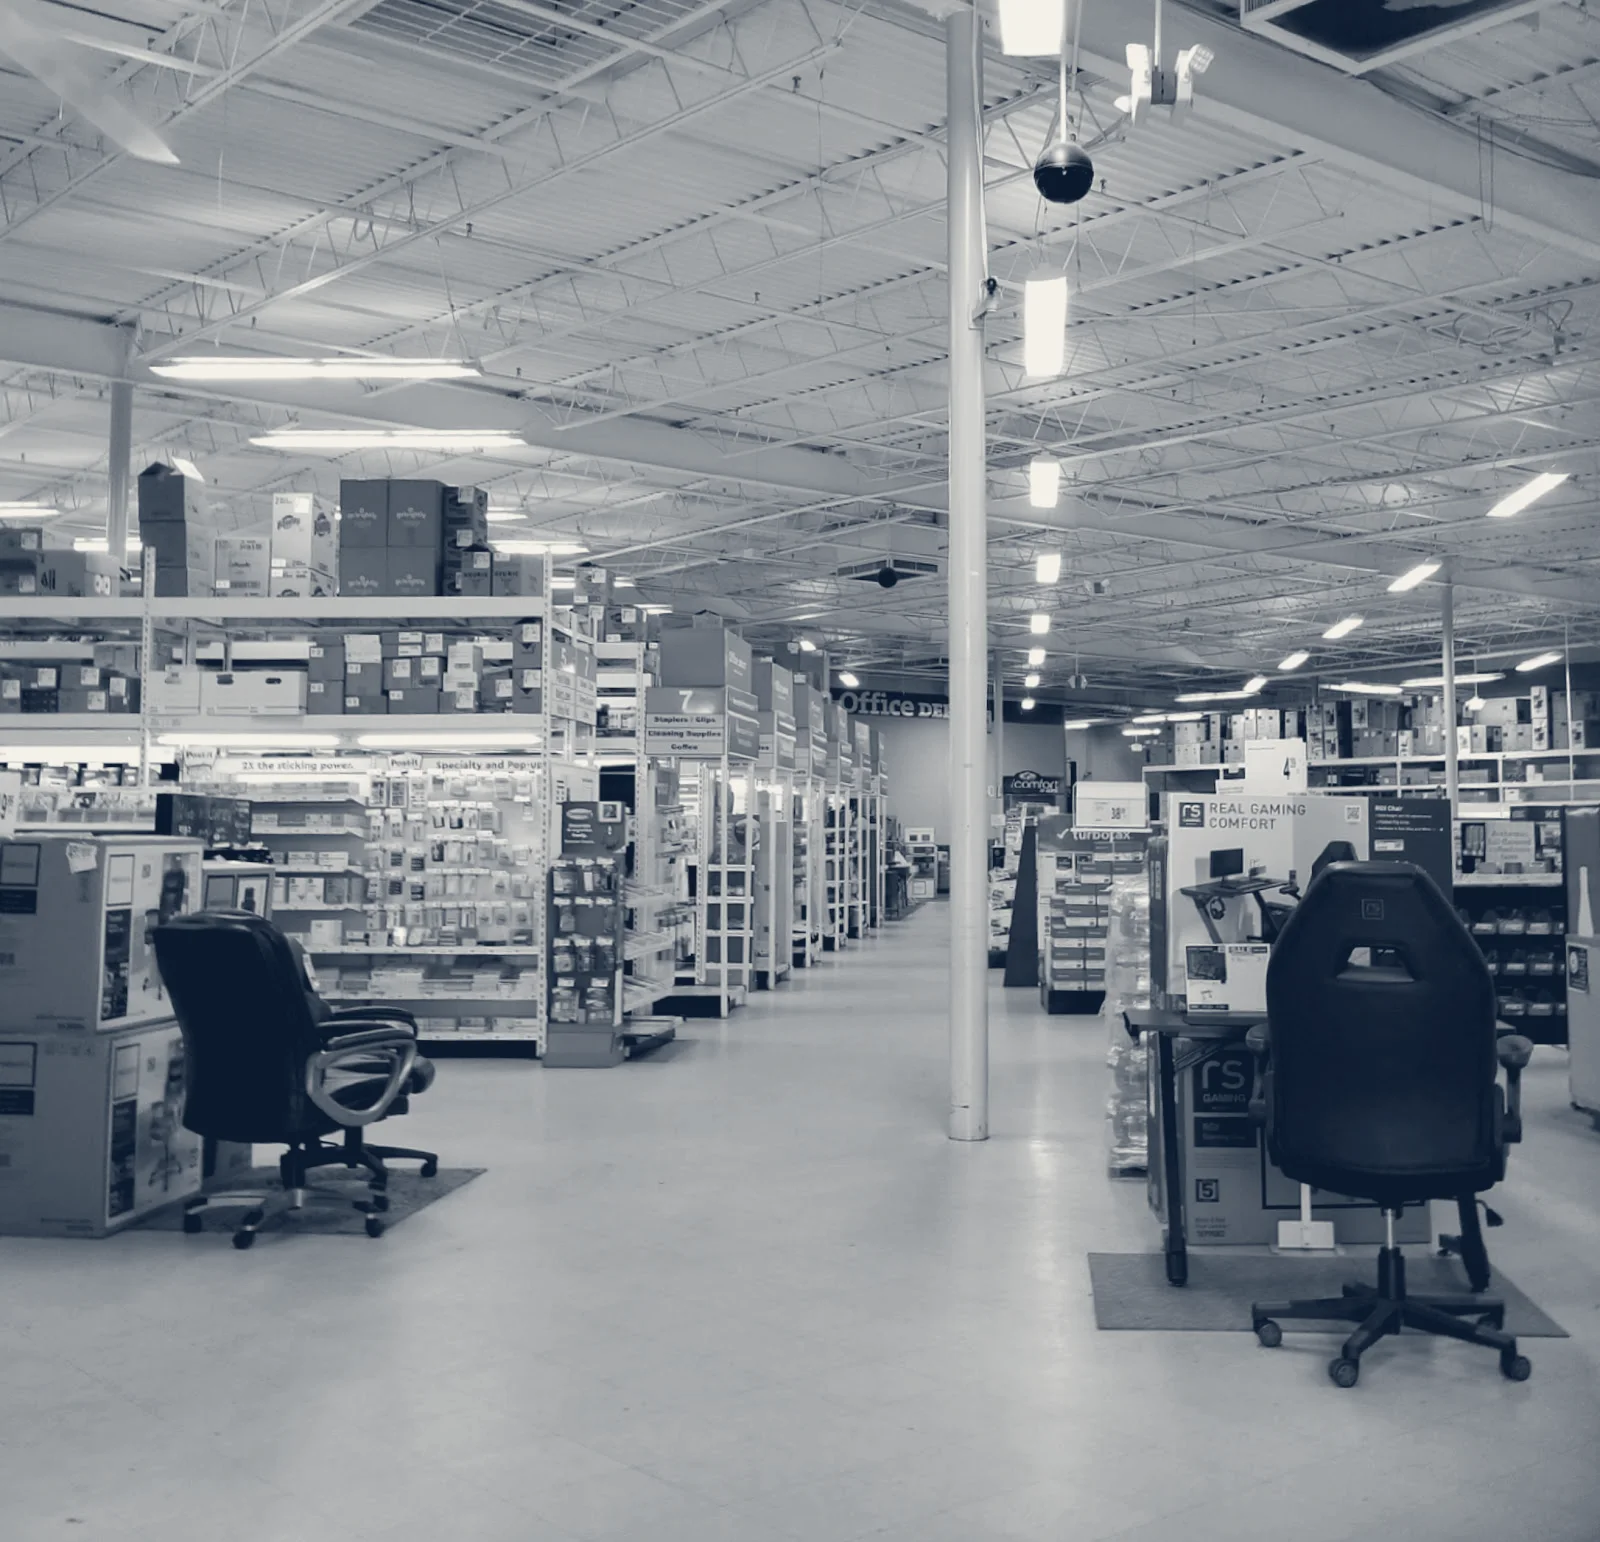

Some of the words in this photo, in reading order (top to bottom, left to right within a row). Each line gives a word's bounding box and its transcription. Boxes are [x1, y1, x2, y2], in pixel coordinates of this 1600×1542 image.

[679, 690, 693, 713] 7
[840, 691, 915, 716] Office
[654, 716, 688, 724] Staplers
[695, 716, 716, 724] Clips
[648, 730, 684, 738] Cleaning
[686, 730, 722, 738] Supplies
[257, 760, 274, 769] the
[278, 760, 317, 773] sticking
[436, 760, 482, 770] Specialty
[485, 760, 505, 769] and
[1209, 803, 1244, 814] REAL
[1250, 803, 1307, 815] GAMING
[1209, 818, 1276, 829] COMFORT
